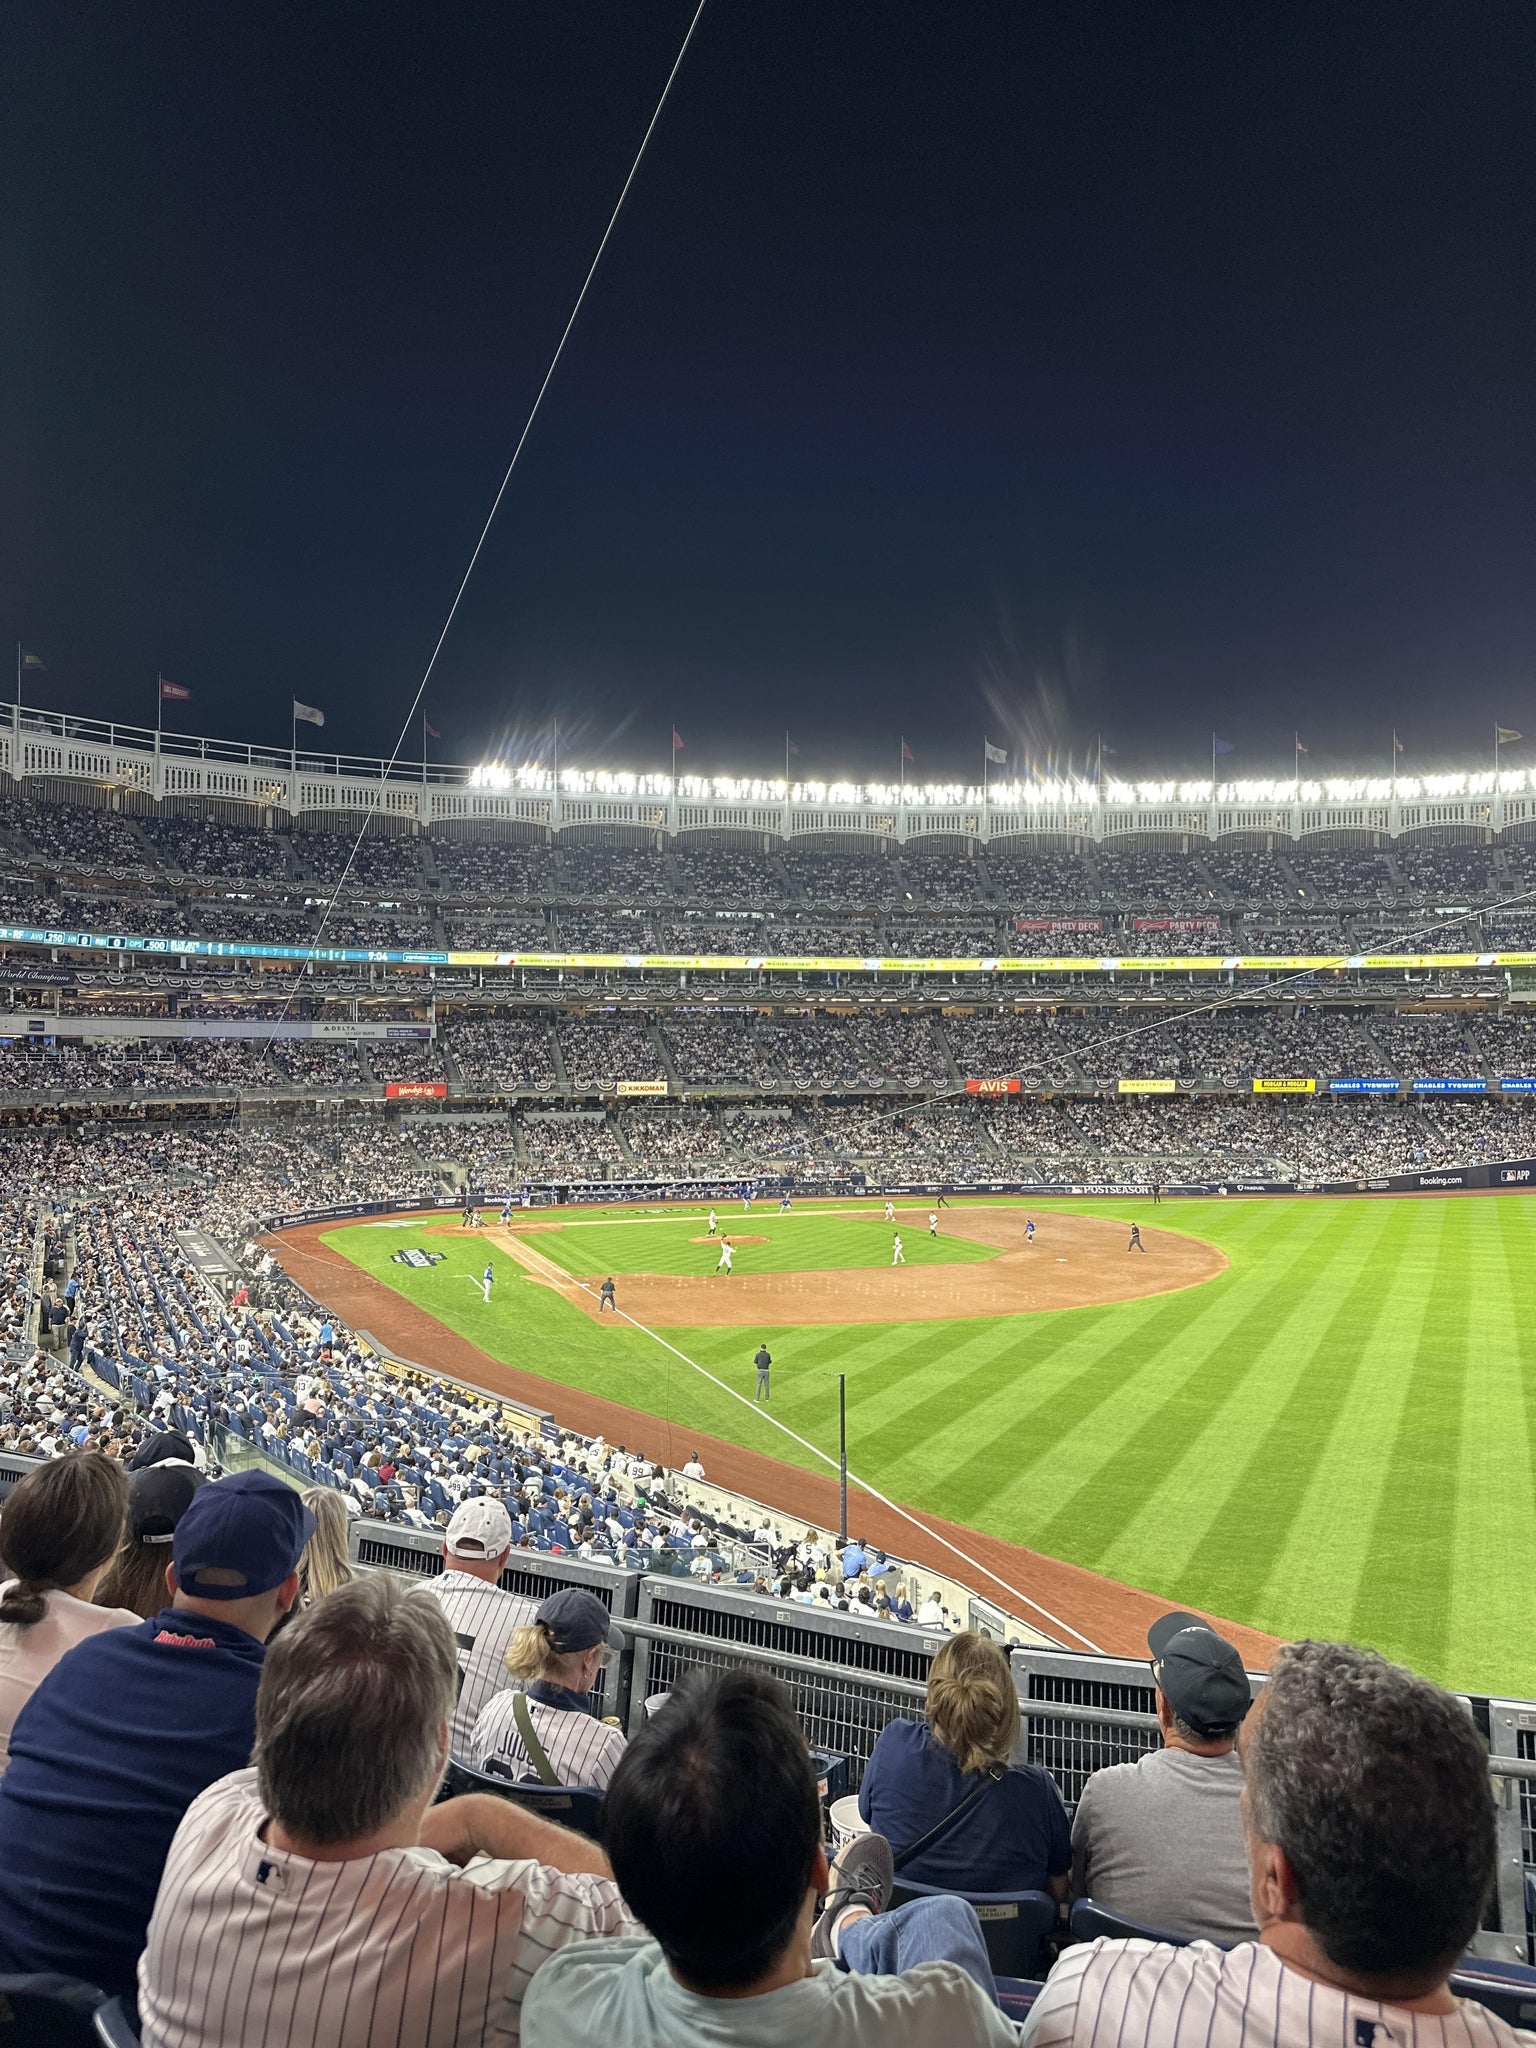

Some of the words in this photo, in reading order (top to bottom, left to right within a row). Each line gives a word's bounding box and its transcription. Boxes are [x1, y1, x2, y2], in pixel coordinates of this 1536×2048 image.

[81, 936, 88, 945] 0
[113, 938, 121, 947] 0
[146, 941, 165, 949] .500
[368, 951, 388, 961] 9:04
[27, 971, 69, 982] Champions
[979, 1081, 1008, 1091] AVIS
[1516, 1170, 1530, 1181] APP
[1420, 1176, 1462, 1186] Booking.com
[1083, 1186, 1149, 1194] POSTSEASON
[237, 1344, 246, 1352] 10
[298, 1382, 306, 1391] 13
[632, 1466, 644, 1476] 99
[452, 1482, 461, 1492] 99
[805, 1544, 812, 1555] 5
